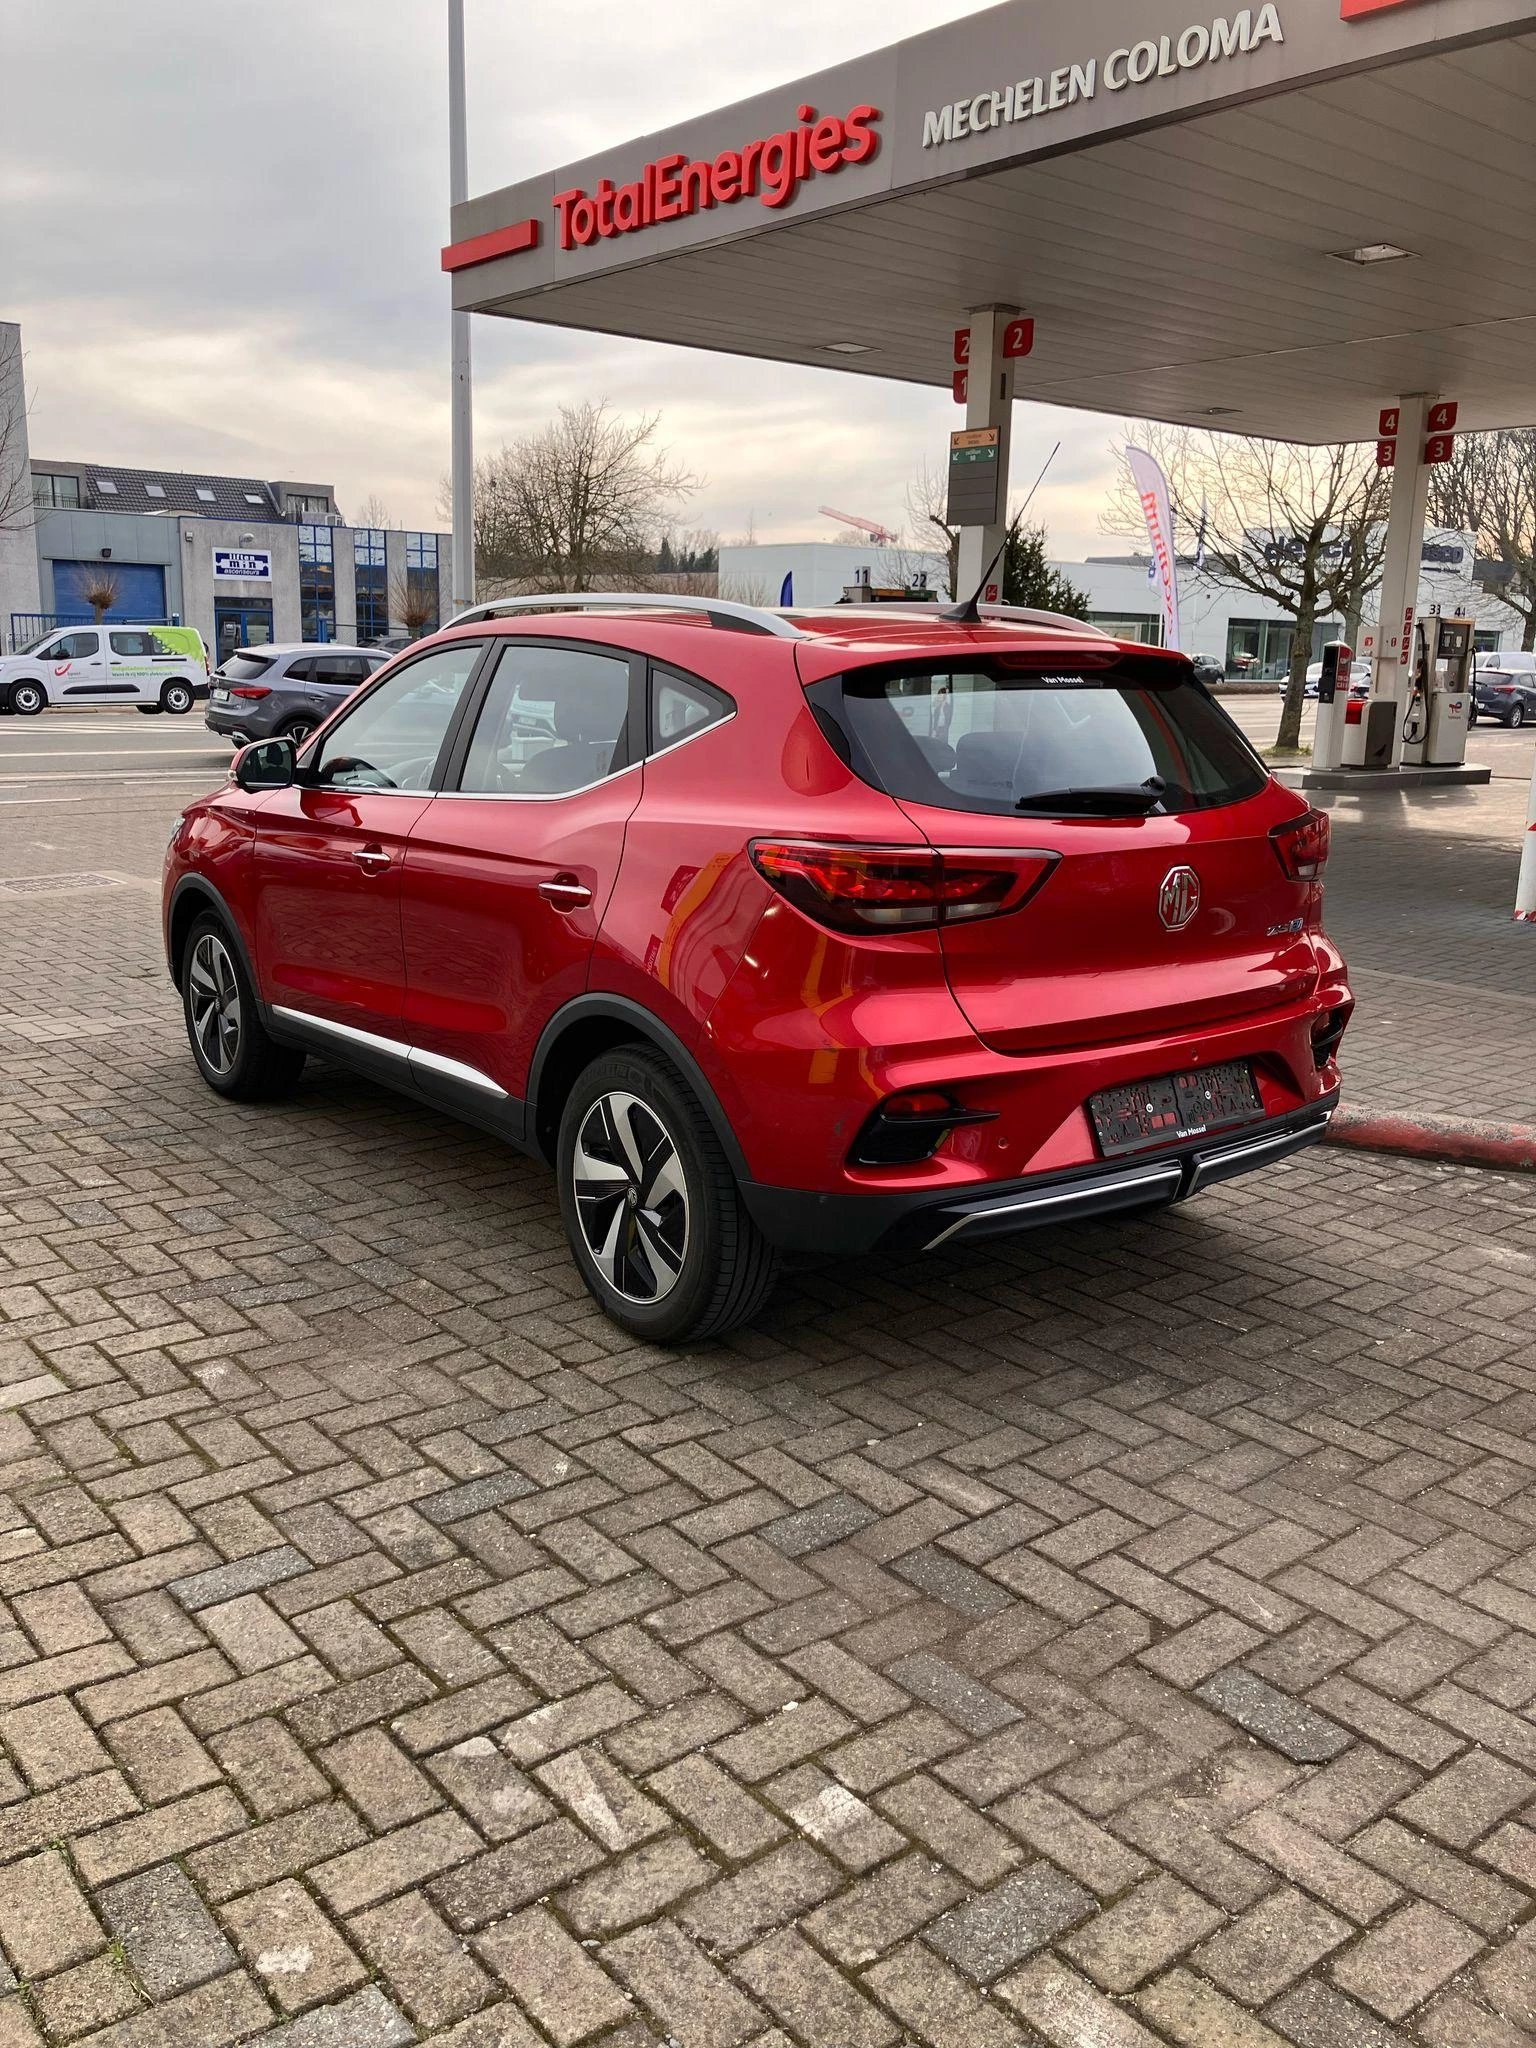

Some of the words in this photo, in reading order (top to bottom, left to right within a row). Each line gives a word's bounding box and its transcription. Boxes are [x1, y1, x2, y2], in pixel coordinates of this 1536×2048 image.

[922, 58, 1096, 149] MECHELEN
[1103, 3, 1284, 91] COLOMA
[552, 103, 879, 250] TotalEnergies
[961, 336, 970, 357] 2
[1012, 327, 1023, 349] 2
[961, 376, 968, 397] 1
[1385, 414, 1396, 430] 4
[1436, 409, 1448, 425] 4
[1383, 445, 1393, 462] 3
[1434, 441, 1444, 458] 3
[229, 560, 256, 569] min
[1041, 676, 1058, 684] Van
[1057, 676, 1084, 684] Mossel
[1162, 872, 1198, 925] MG
[1176, 1130, 1188, 1138] Van
[1187, 1124, 1207, 1136] Mossel
